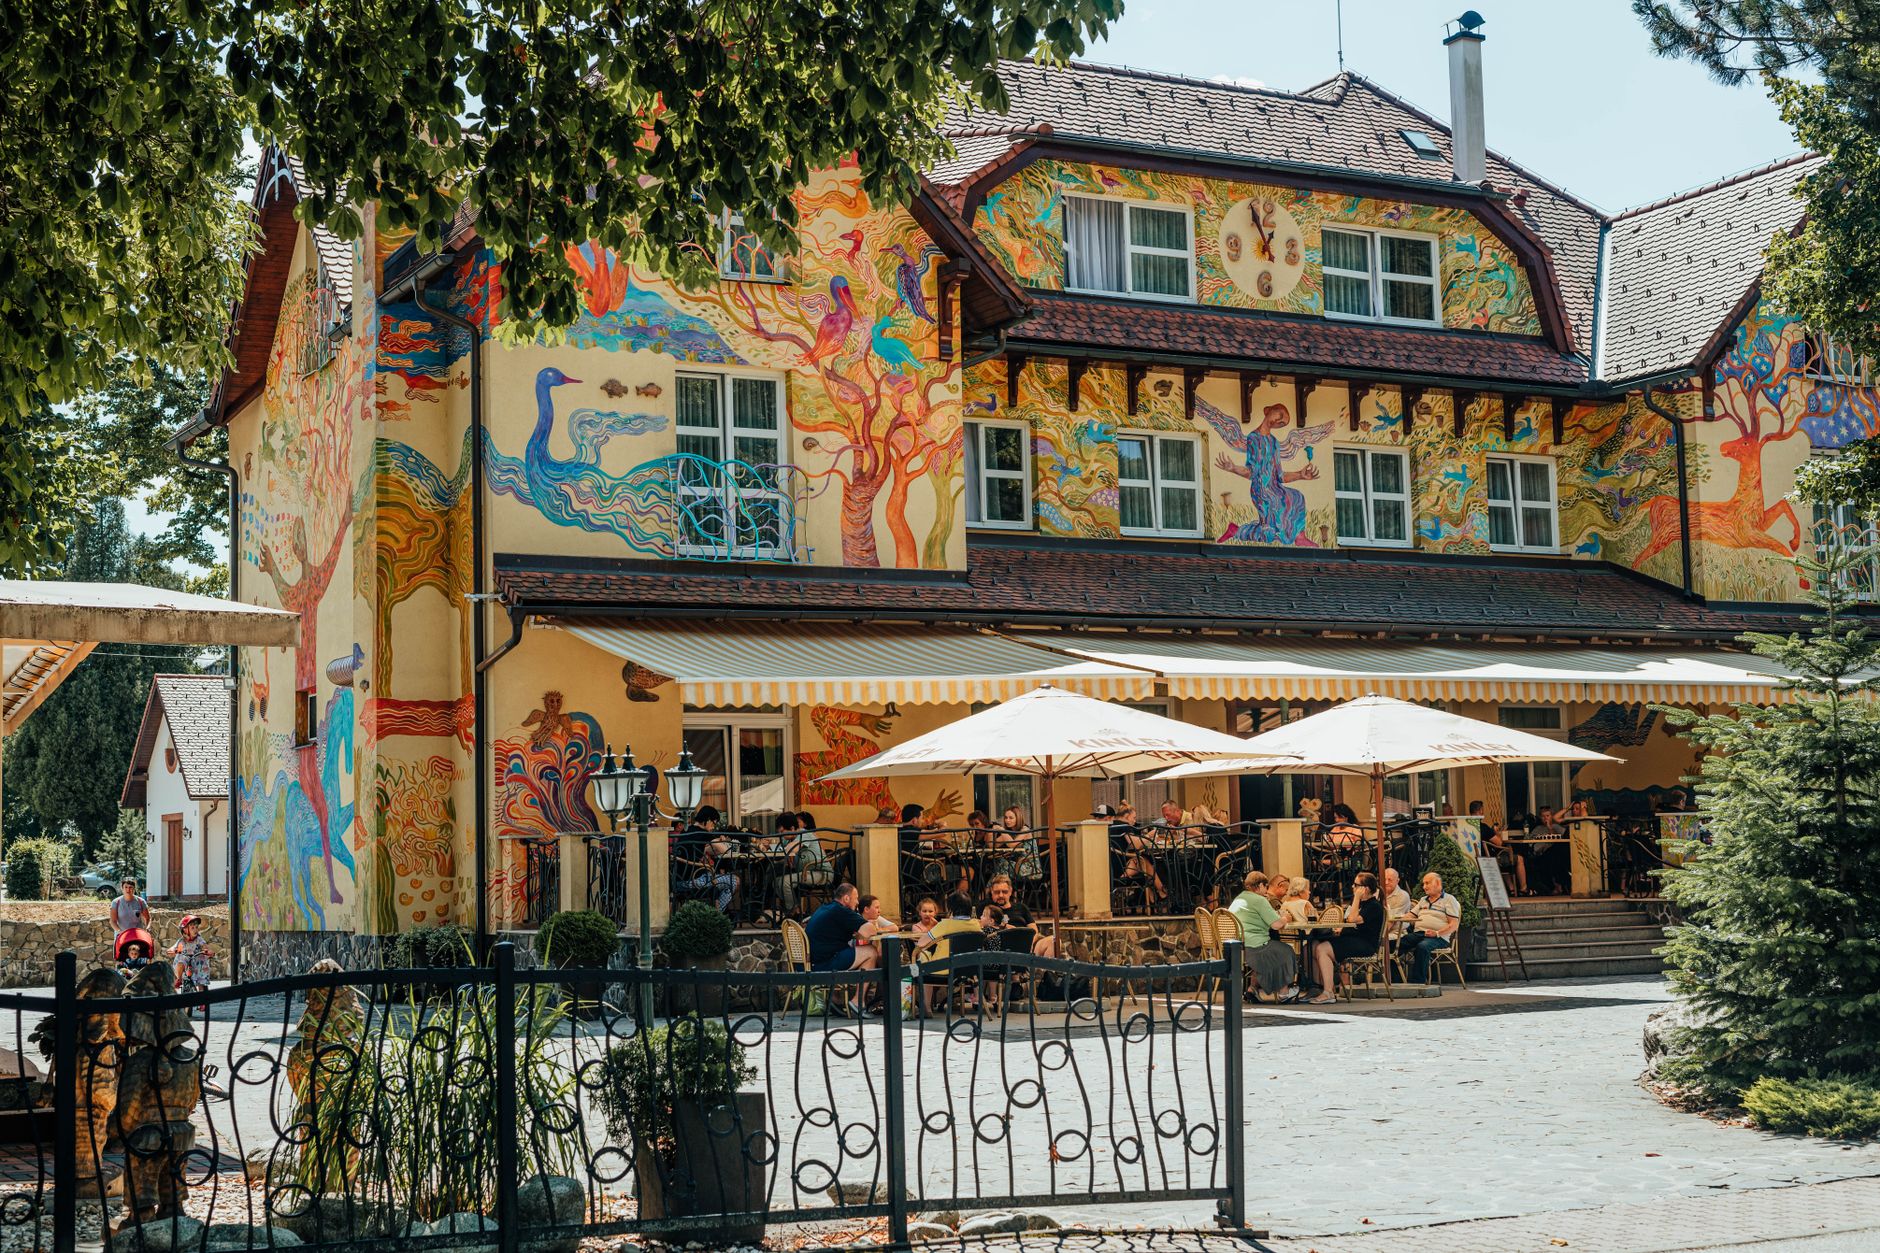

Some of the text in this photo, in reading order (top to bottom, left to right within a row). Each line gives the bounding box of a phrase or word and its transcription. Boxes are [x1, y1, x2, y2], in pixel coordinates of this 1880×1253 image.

[1226, 234, 1242, 262] 9
[1285, 238, 1300, 266] 3
[1257, 270, 1273, 298] 6
[1067, 737, 1178, 749] KINLEY
[1428, 741, 1520, 753] KINLEY
